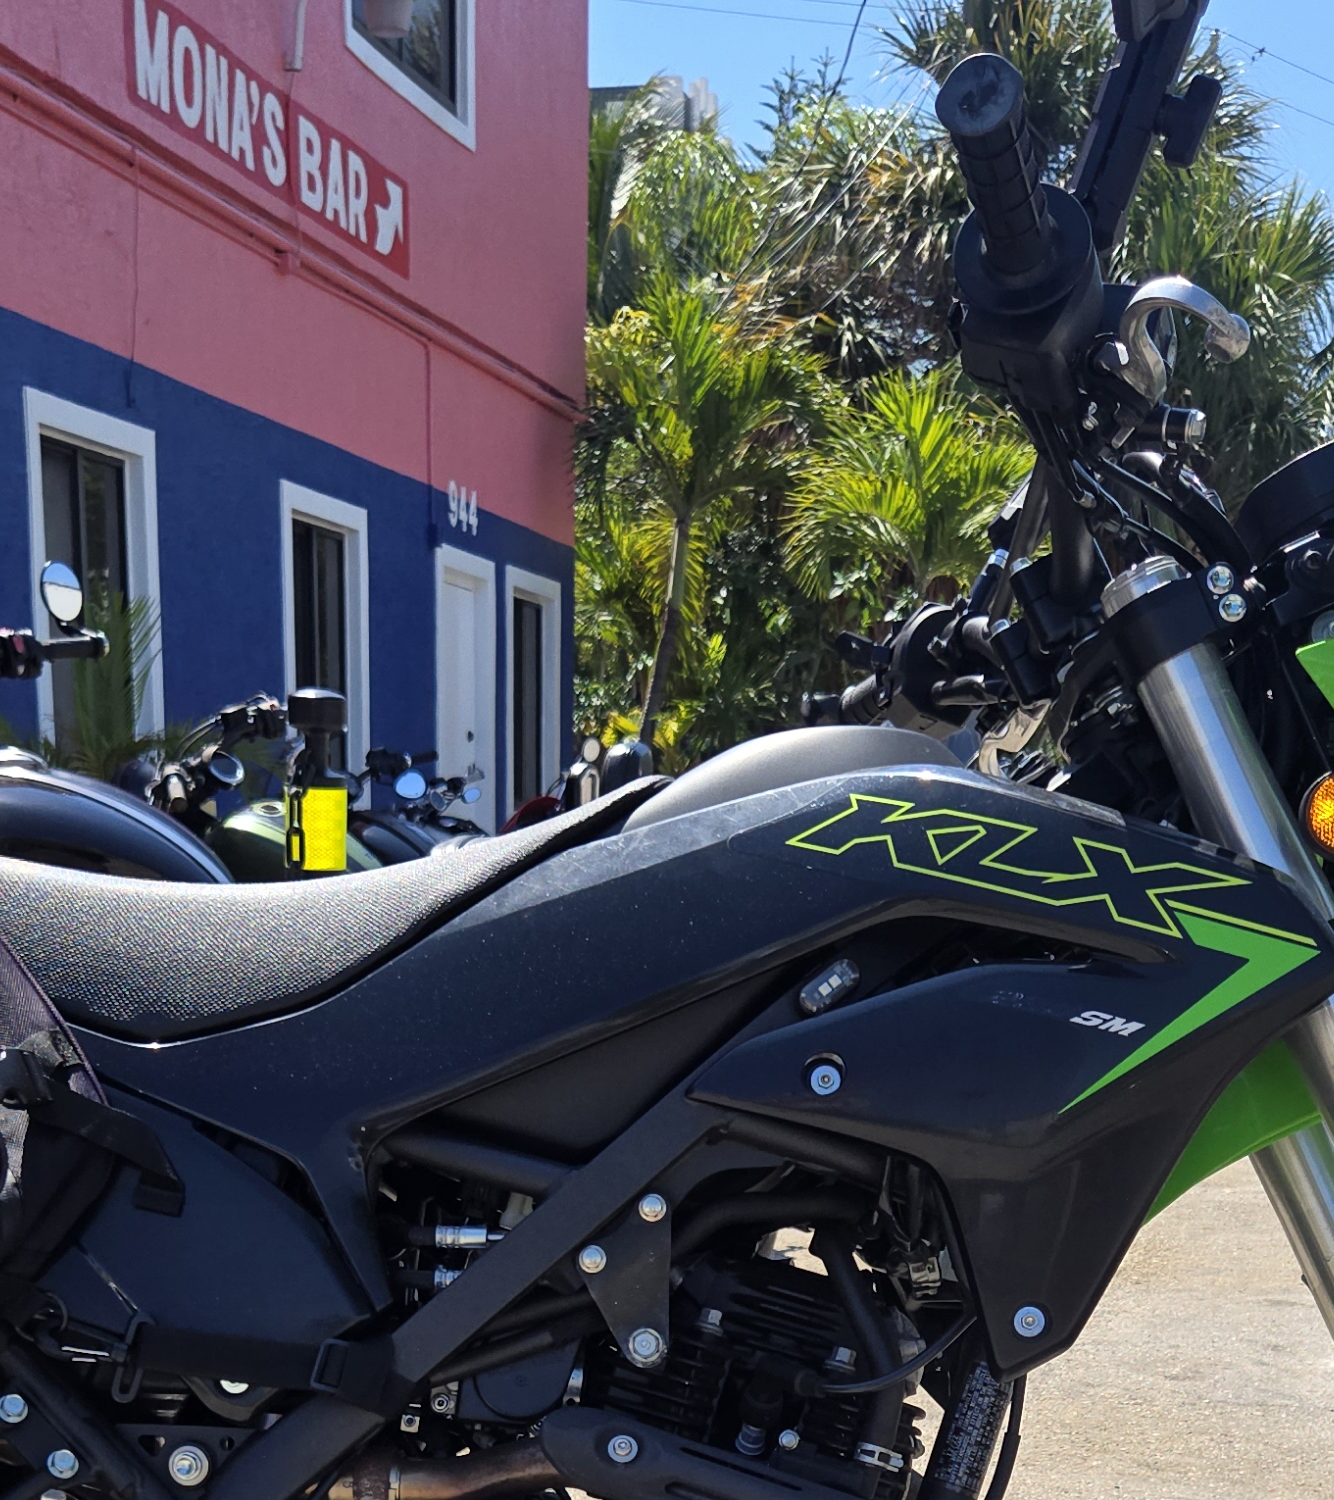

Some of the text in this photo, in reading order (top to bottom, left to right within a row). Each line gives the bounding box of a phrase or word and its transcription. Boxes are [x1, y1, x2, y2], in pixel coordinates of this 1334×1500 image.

[132, 0, 368, 245] MONA'S BAR
[448, 480, 478, 536] 944
[786, 793, 1253, 939] KLX
[1069, 1010, 1146, 1037] SM
